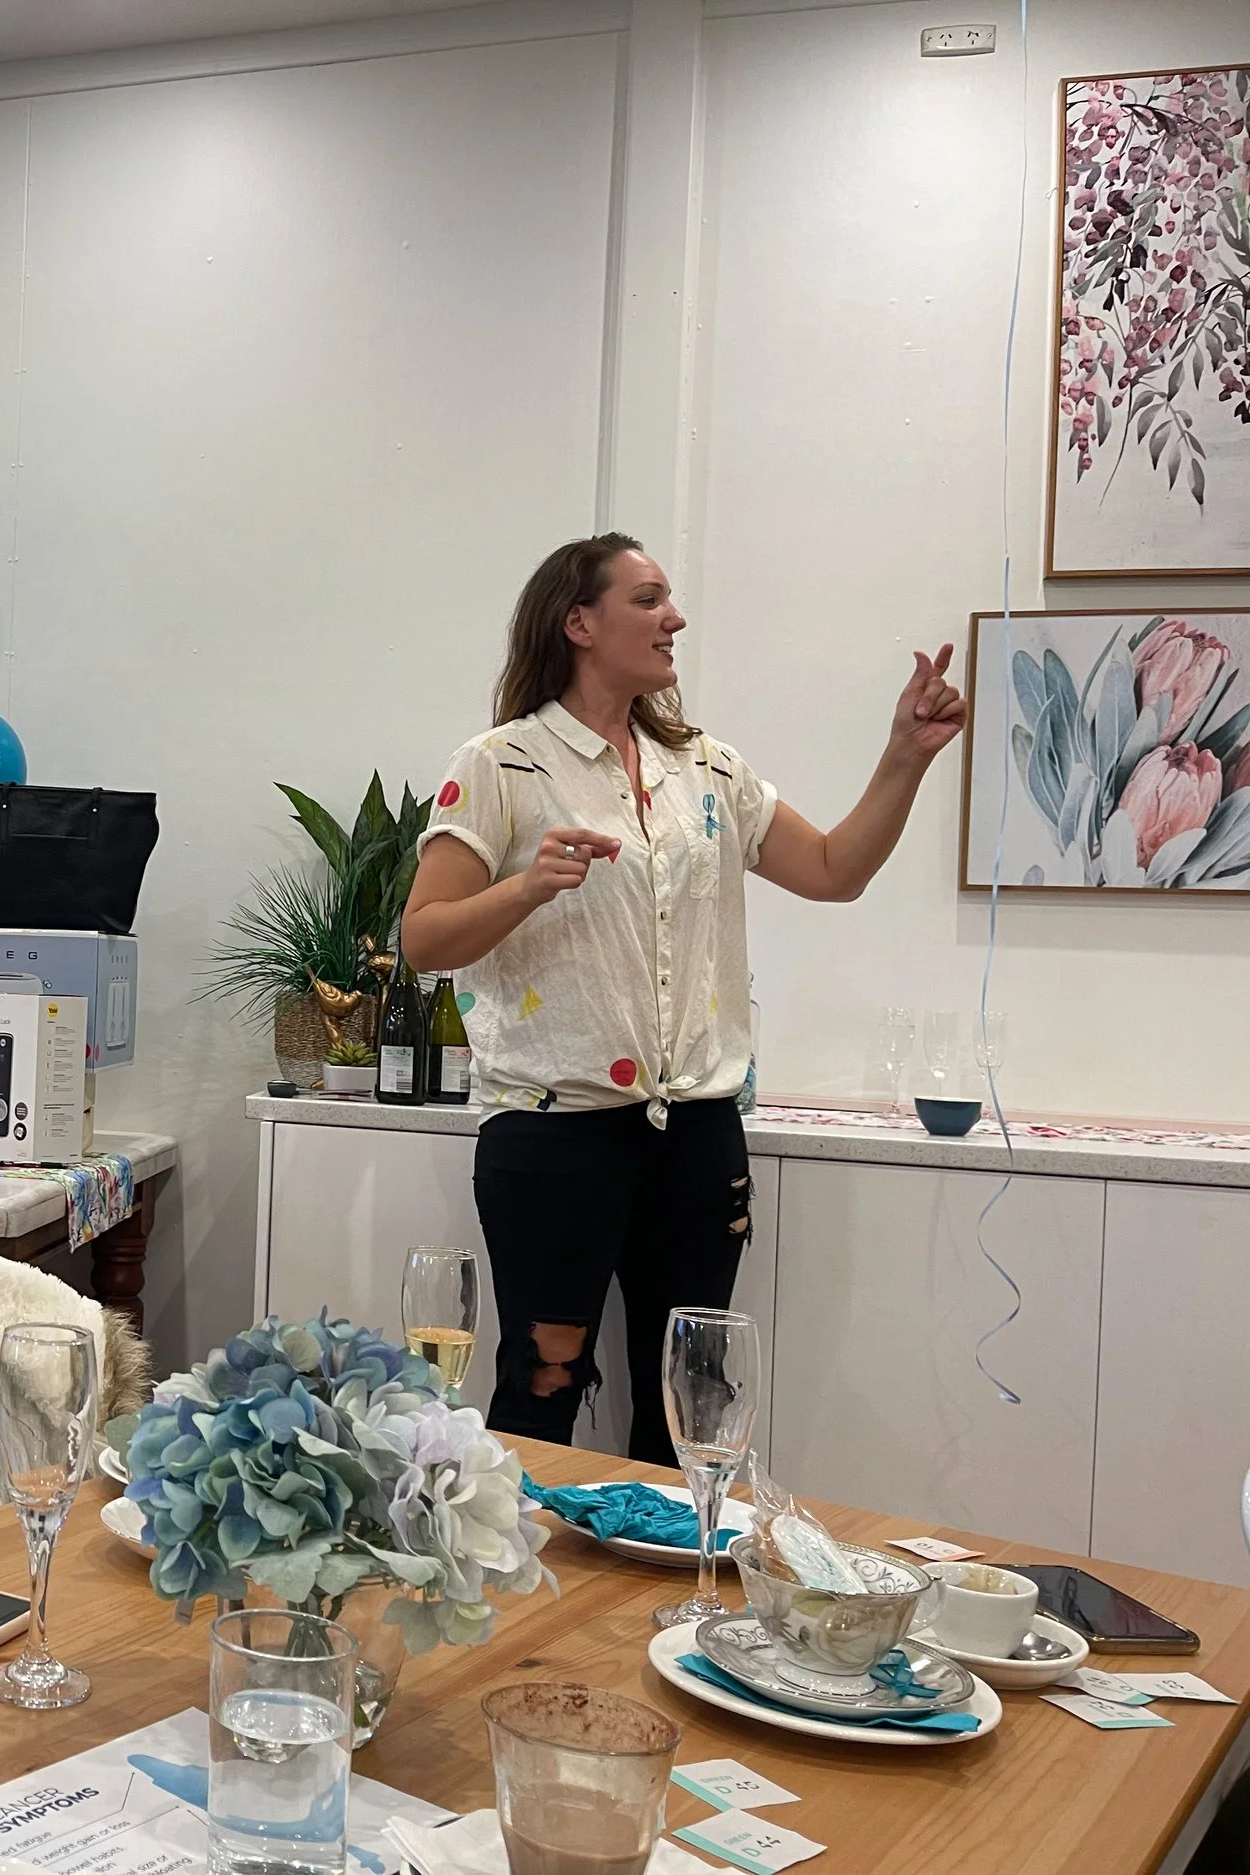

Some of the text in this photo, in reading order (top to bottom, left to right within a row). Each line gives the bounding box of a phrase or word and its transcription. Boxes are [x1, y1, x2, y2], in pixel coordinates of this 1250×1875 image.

[714, 1781, 760, 1794] D 45
[16, 1831, 53, 1849] fatigue
[41, 1843, 78, 1861] weight
[77, 1832, 99, 1846] gain
[99, 1828, 109, 1836] or
[108, 1820, 131, 1831] loss
[742, 1836, 781, 1857] D 44
